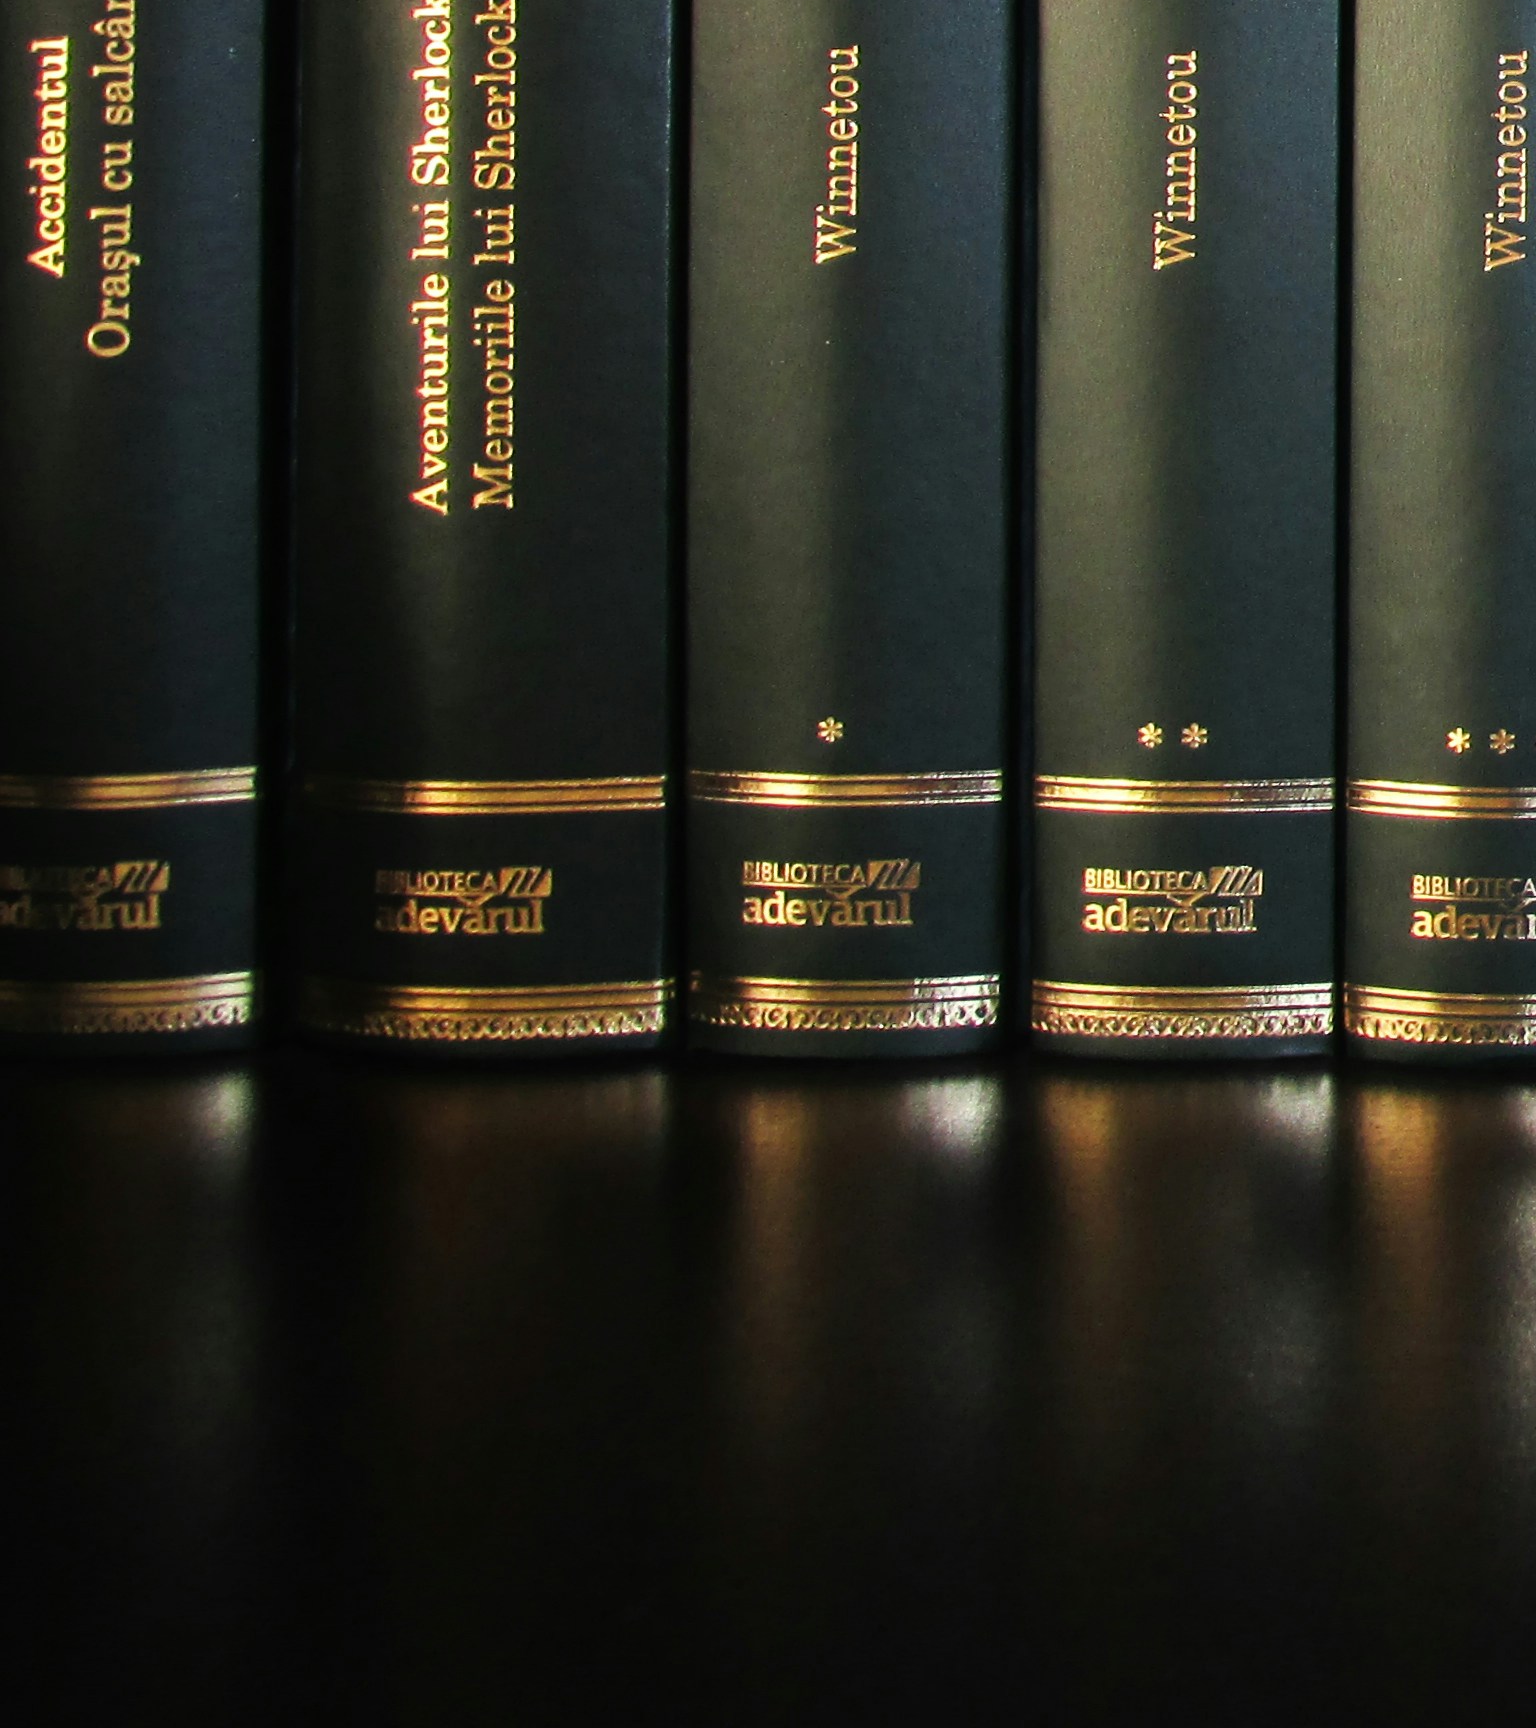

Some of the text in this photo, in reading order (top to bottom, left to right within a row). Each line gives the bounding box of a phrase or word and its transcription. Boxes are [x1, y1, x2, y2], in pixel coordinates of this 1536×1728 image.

[25, 36, 69, 279] Accidentul
[101, 140, 133, 191] cu
[408, 199, 449, 261] lui
[472, 204, 515, 266] lui
[814, 45, 859, 264] Winnetou
[1153, 50, 1197, 270] Winnetou
[1484, 50, 1528, 272] Winnetou
[408, 274, 449, 517] Aventurile
[471, 280, 515, 509] Memoriile
[742, 862, 867, 884] BIBLIOTECA
[1082, 867, 1209, 891] BIBLIOTECA
